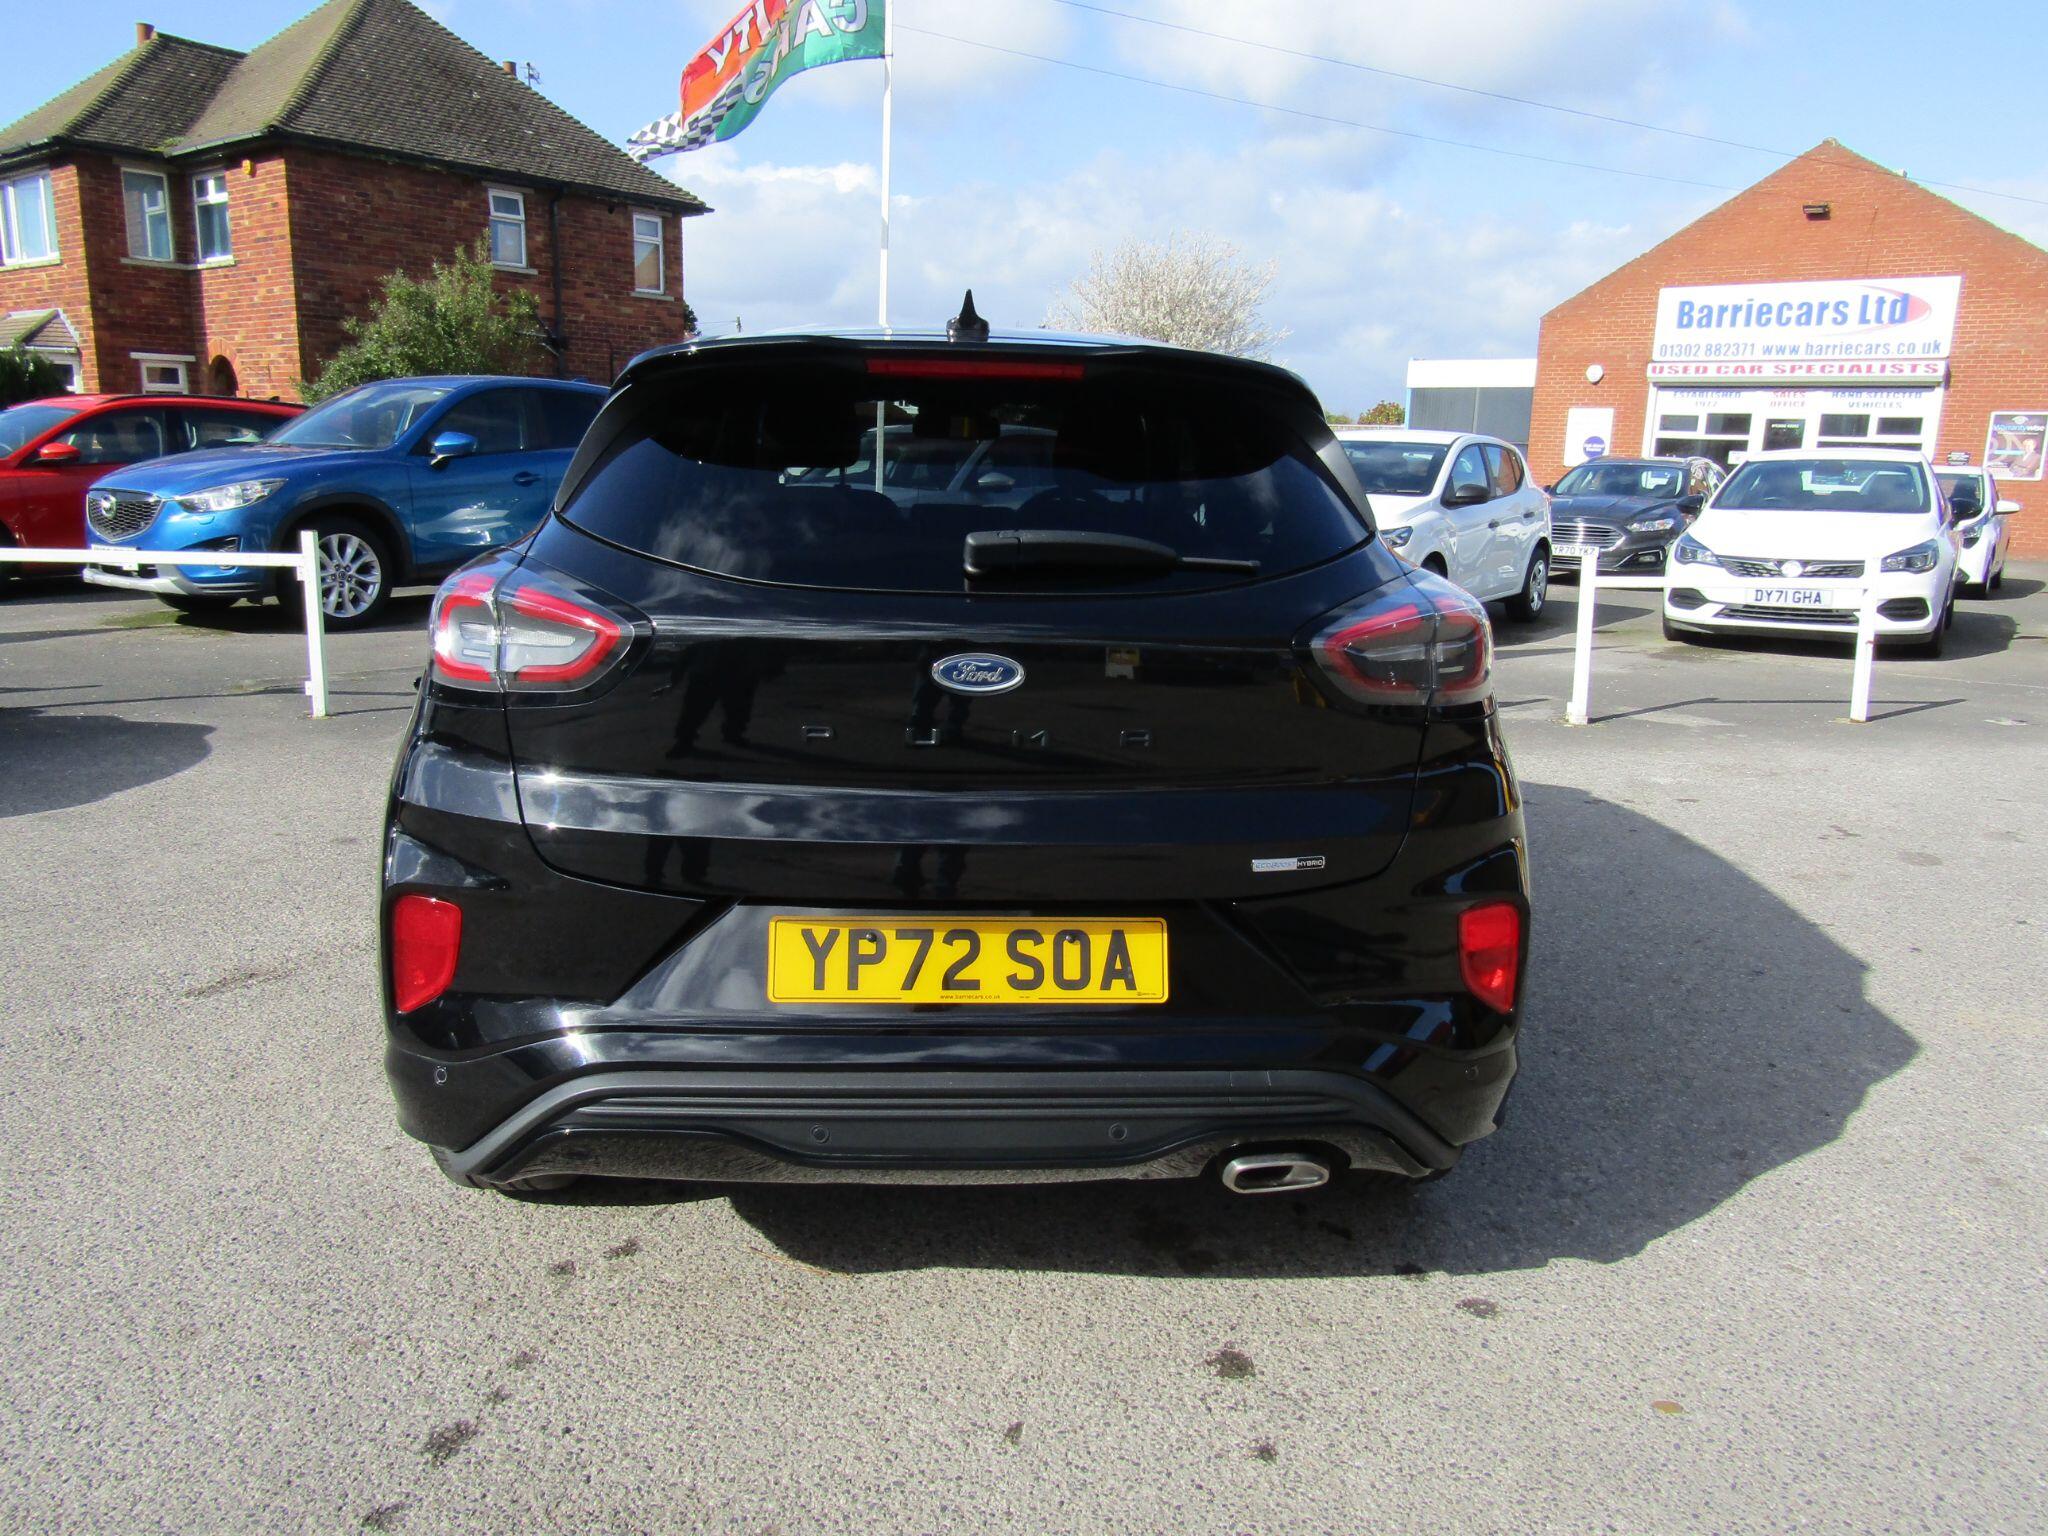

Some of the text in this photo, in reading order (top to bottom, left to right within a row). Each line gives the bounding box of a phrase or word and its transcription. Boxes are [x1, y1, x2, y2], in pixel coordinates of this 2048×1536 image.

[1676, 293, 1910, 330] Barriecars Ltd
[1659, 343, 1701, 358] 01302
[1704, 342, 1755, 358] 882371
[1651, 363, 1939, 375] USED CAR SPECIALISTS
[1848, 401, 1903, 409] VEHICLES
[1755, 589, 1822, 604] DY71 GHA
[952, 660, 1004, 682] Ford
[801, 928, 1137, 991] YP72 SOA
